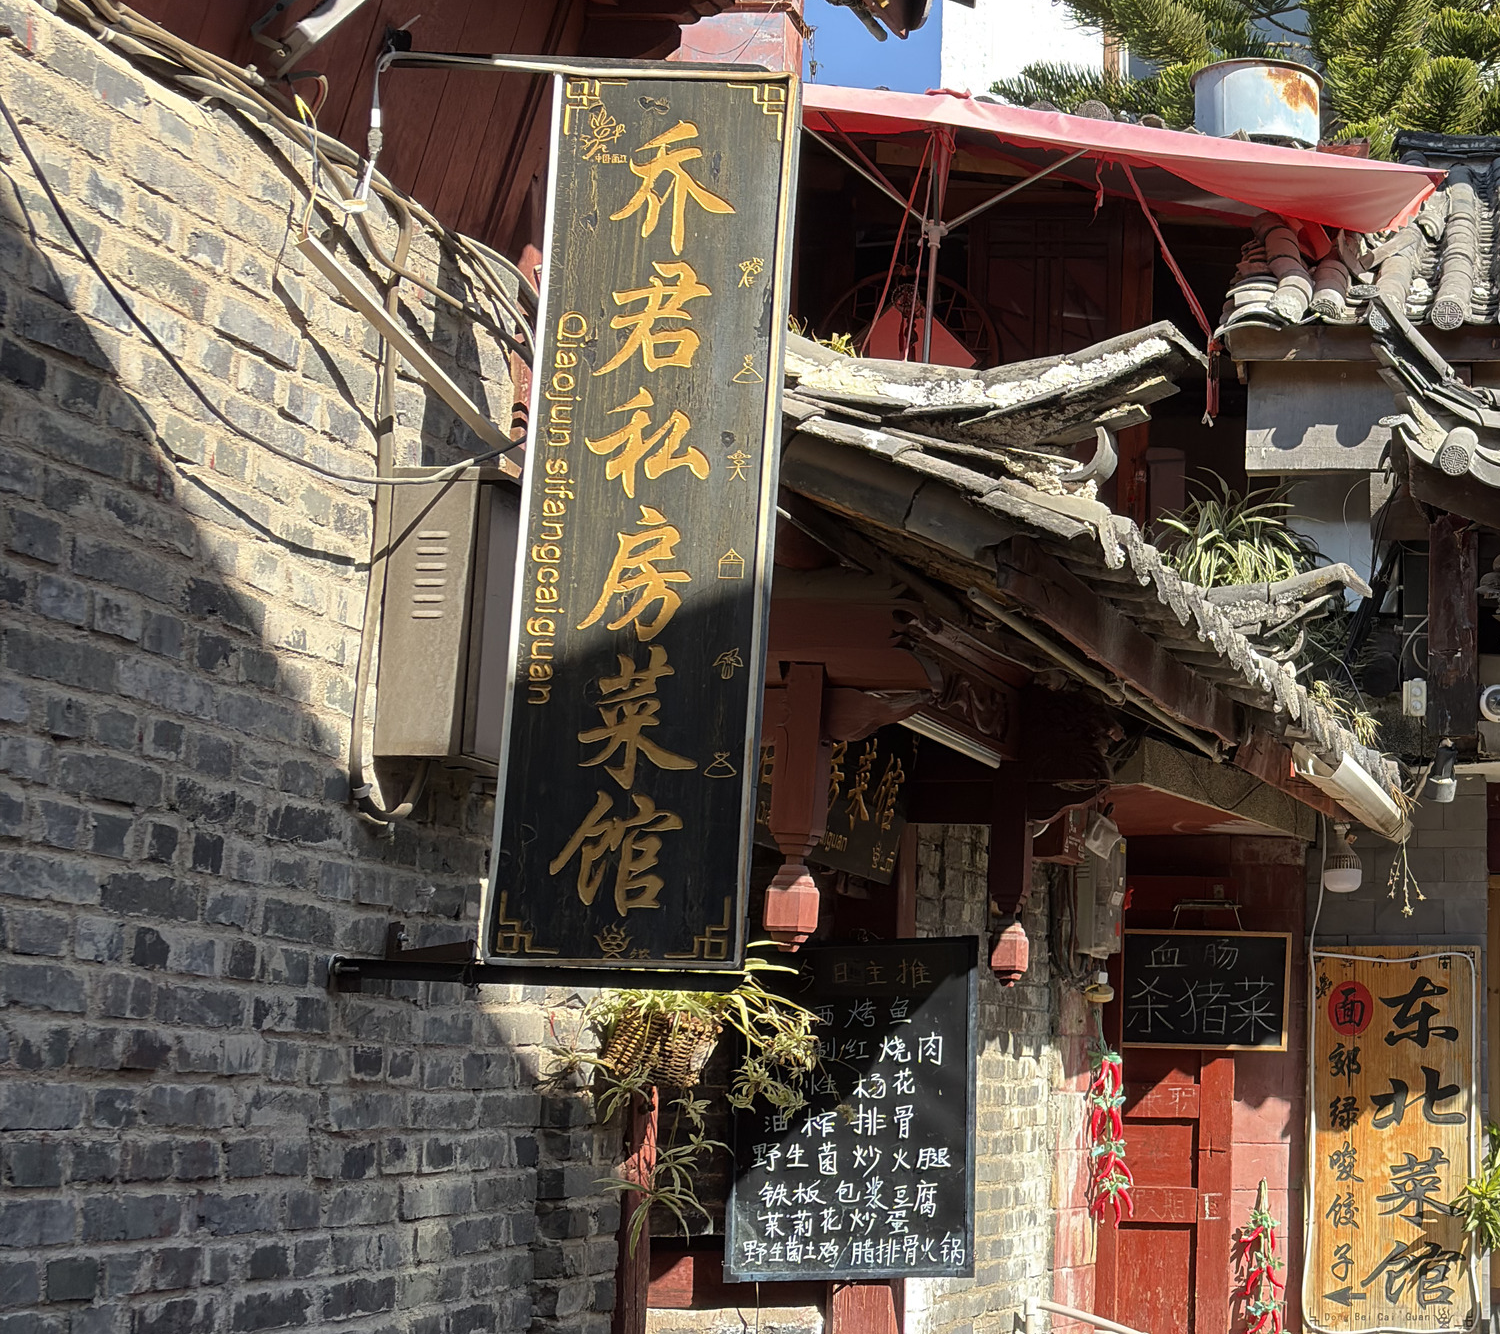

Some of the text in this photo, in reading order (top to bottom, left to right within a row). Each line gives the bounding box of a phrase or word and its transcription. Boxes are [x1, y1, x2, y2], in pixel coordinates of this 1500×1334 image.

[526, 311, 588, 705] Qiaojun sifangcaiguan
[549, 119, 736, 915] 乔君私房菜馆
[798, 958, 933, 993] 今日主推
[1126, 975, 1278, 1042] 杀猪菜
[751, 1142, 952, 1178] 野生菌炒火腿
[1360, 975, 1467, 1311] 东北菜馆
[759, 1175, 938, 1219] 铁板包浆豆腐
[757, 1209, 909, 1238] 茉莉花炒蛋
[1354, 1312, 1372, 1322] Bei
[1405, 1312, 1431, 1322] Guan
